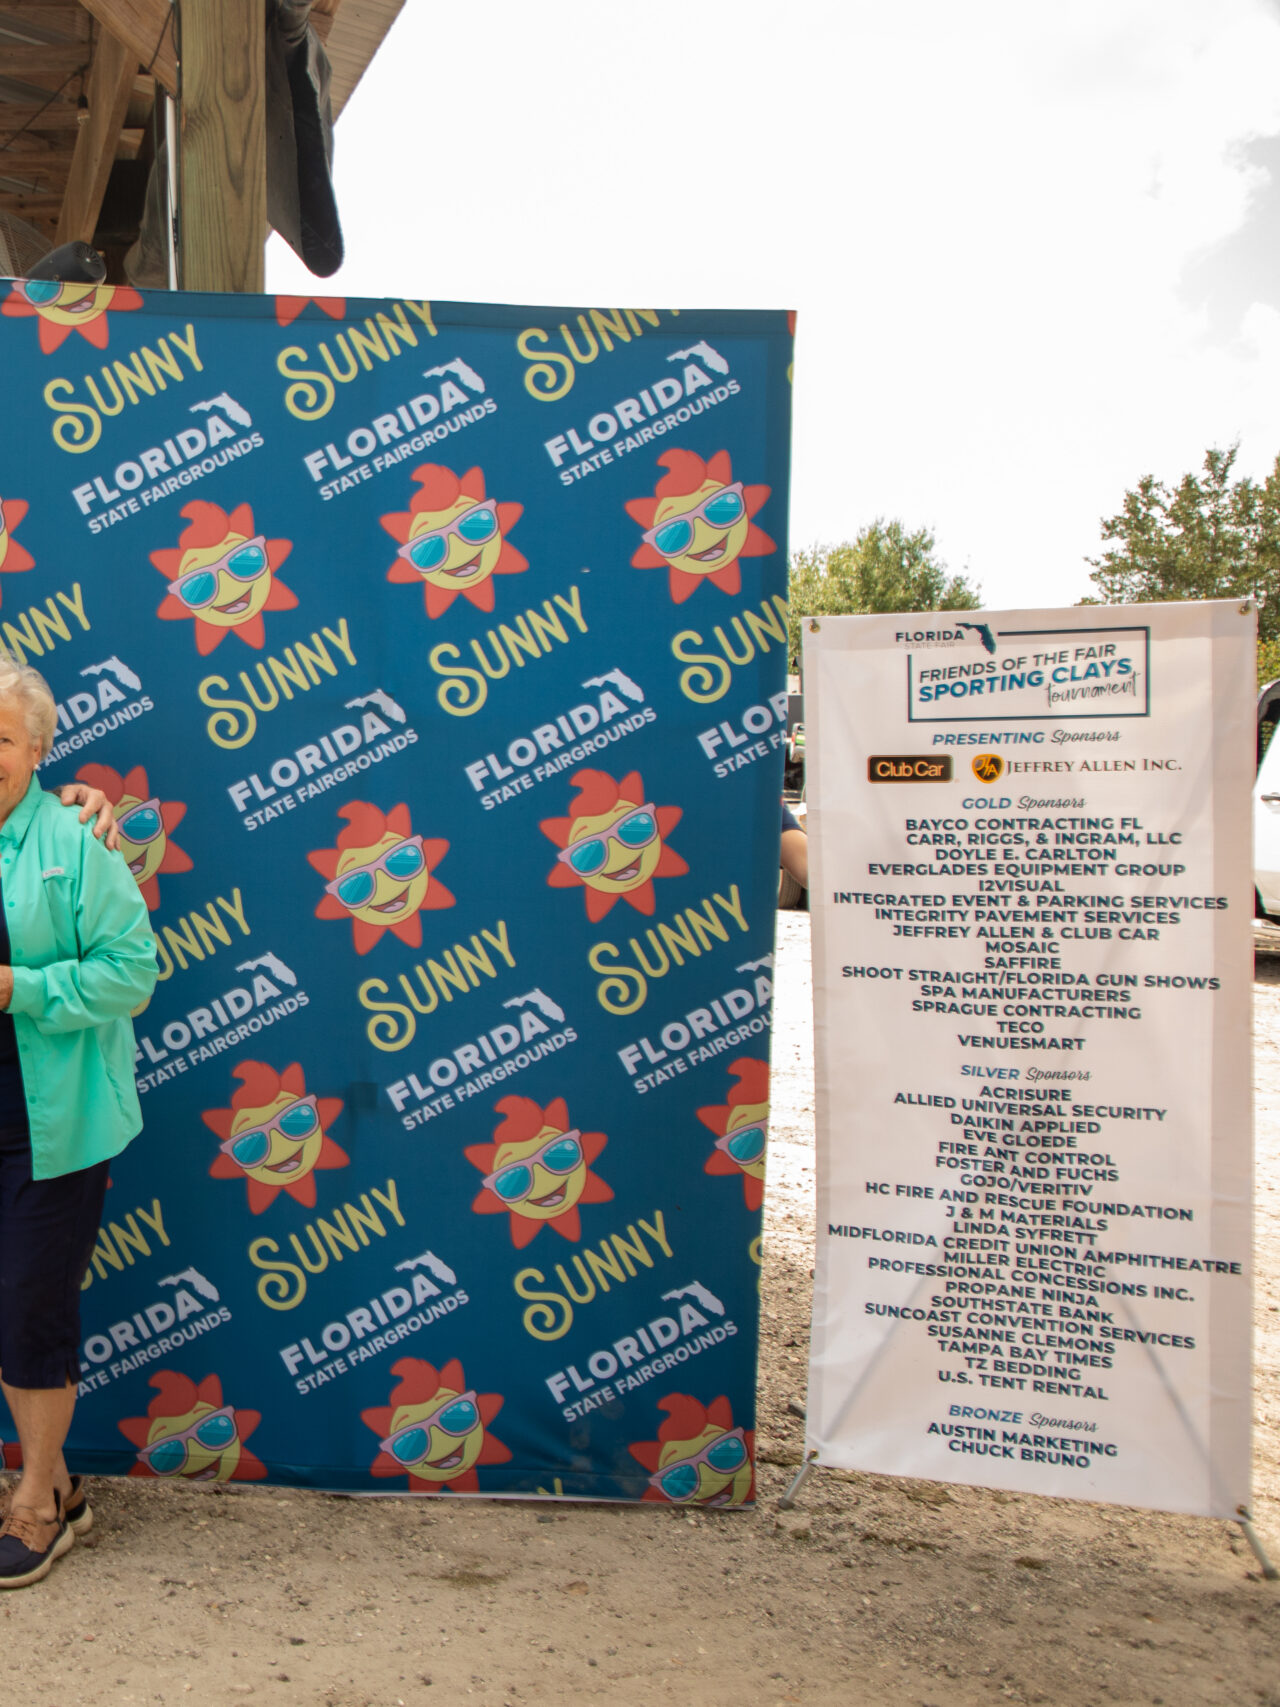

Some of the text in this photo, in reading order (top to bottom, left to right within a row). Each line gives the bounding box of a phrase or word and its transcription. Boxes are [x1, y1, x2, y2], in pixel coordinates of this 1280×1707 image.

[44, 323, 203, 453] SUNNY
[72, 414, 235, 517] FLORIDA
[88, 430, 265, 534] STATE FAIRGROUNDS
[896, 630, 964, 642] FLORIDA
[429, 586, 588, 716] SUNNY
[920, 644, 1116, 682] FRIENDS OF THE FAIR
[200, 618, 357, 749] SUNNY
[919, 658, 1131, 702] SPORTING CLAYS
[465, 690, 628, 793] FLORIDA
[933, 729, 1121, 746] PRESENTING Sponsors
[227, 711, 390, 814] FLORIDA
[481, 705, 656, 811] STATE FAIRGROUNDS
[1007, 759, 1182, 775] JEFFREY ALLEN INC.
[244, 726, 419, 831] STATE FAIRGROUNDS
[962, 796, 1085, 811] GOLD Sponsors
[906, 818, 1143, 831] BAYCO CONTRACTING FL
[906, 832, 1182, 847] CARR, RIGGS, & INGRAM, LLC
[936, 849, 1116, 860] DOYLE E. CARLTON
[868, 864, 1185, 878] EVERGLADES EQUIPMENT GROUP
[986, 942, 1059, 954] MOSAIC
[984, 957, 1061, 969] SAFFIRE
[359, 921, 517, 1051] SUNNY
[996, 1021, 1044, 1033] TECO
[958, 1035, 1085, 1050] VENUESMART
[386, 1009, 549, 1114] FLORIDA
[961, 1065, 1090, 1083] SILVER Sponsors
[402, 1025, 577, 1131] STATE FAIRGROUNDS
[979, 1086, 1071, 1101] ACRISURE
[951, 1113, 1101, 1133] DAIKIN APPLIED
[961, 1174, 1092, 1195] GOJO/VERITIV
[953, 1221, 1097, 1245] LINDA SYFRETT
[514, 1207, 672, 1343] SUNNY
[946, 1281, 1099, 1307] PROPANE NINJA
[545, 1301, 708, 1406] FLORIDA
[563, 1318, 737, 1423] STATE FAIRGROUNDS
[964, 1357, 1081, 1380] TZ BEDDING
[938, 1370, 1108, 1400] U.S. TENT RENTAL
[949, 1405, 1098, 1432] BRONZE Sponsors
[927, 1423, 1117, 1457] AUSTIN MARKETING
[949, 1440, 1090, 1468] CHUCK BRUNO
